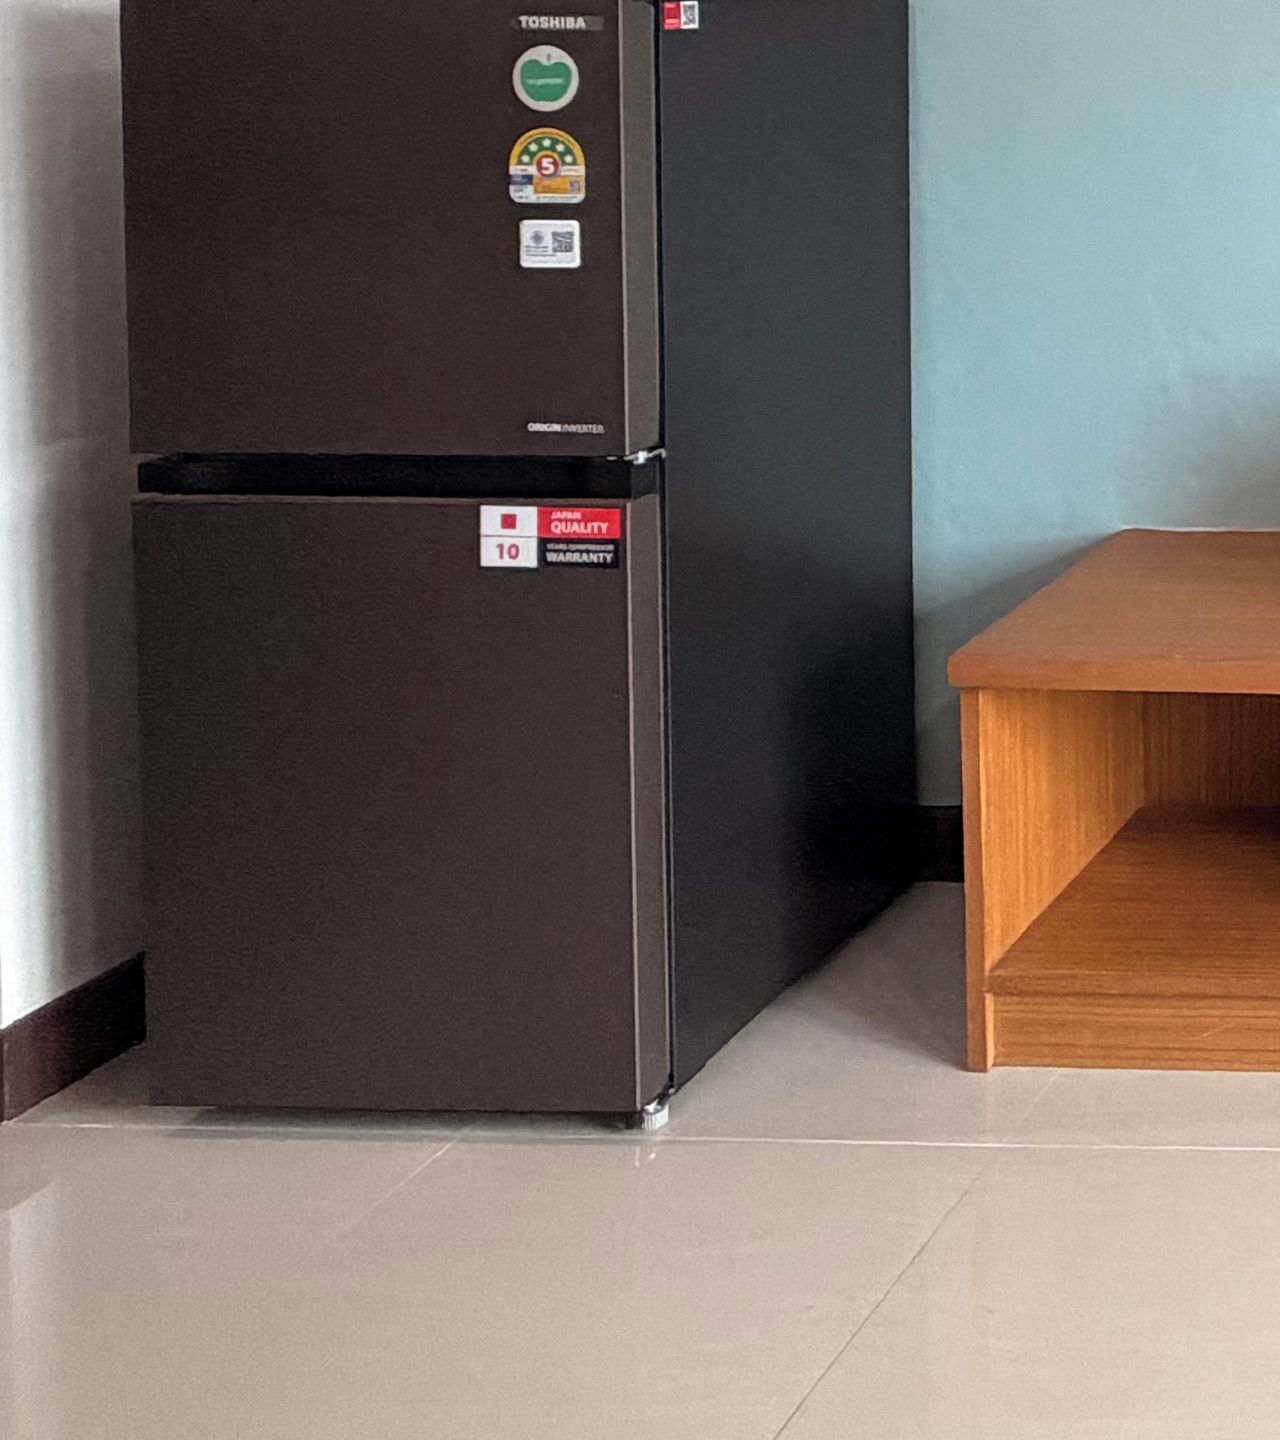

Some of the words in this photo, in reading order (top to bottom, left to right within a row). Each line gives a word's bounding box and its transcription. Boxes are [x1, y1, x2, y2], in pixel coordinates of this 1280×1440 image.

[518, 15, 586, 30] TOSHIBA
[540, 157, 556, 175] 5
[551, 521, 609, 535] QUALITY
[496, 543, 521, 561] 10
[545, 551, 614, 564] WARRANTY
